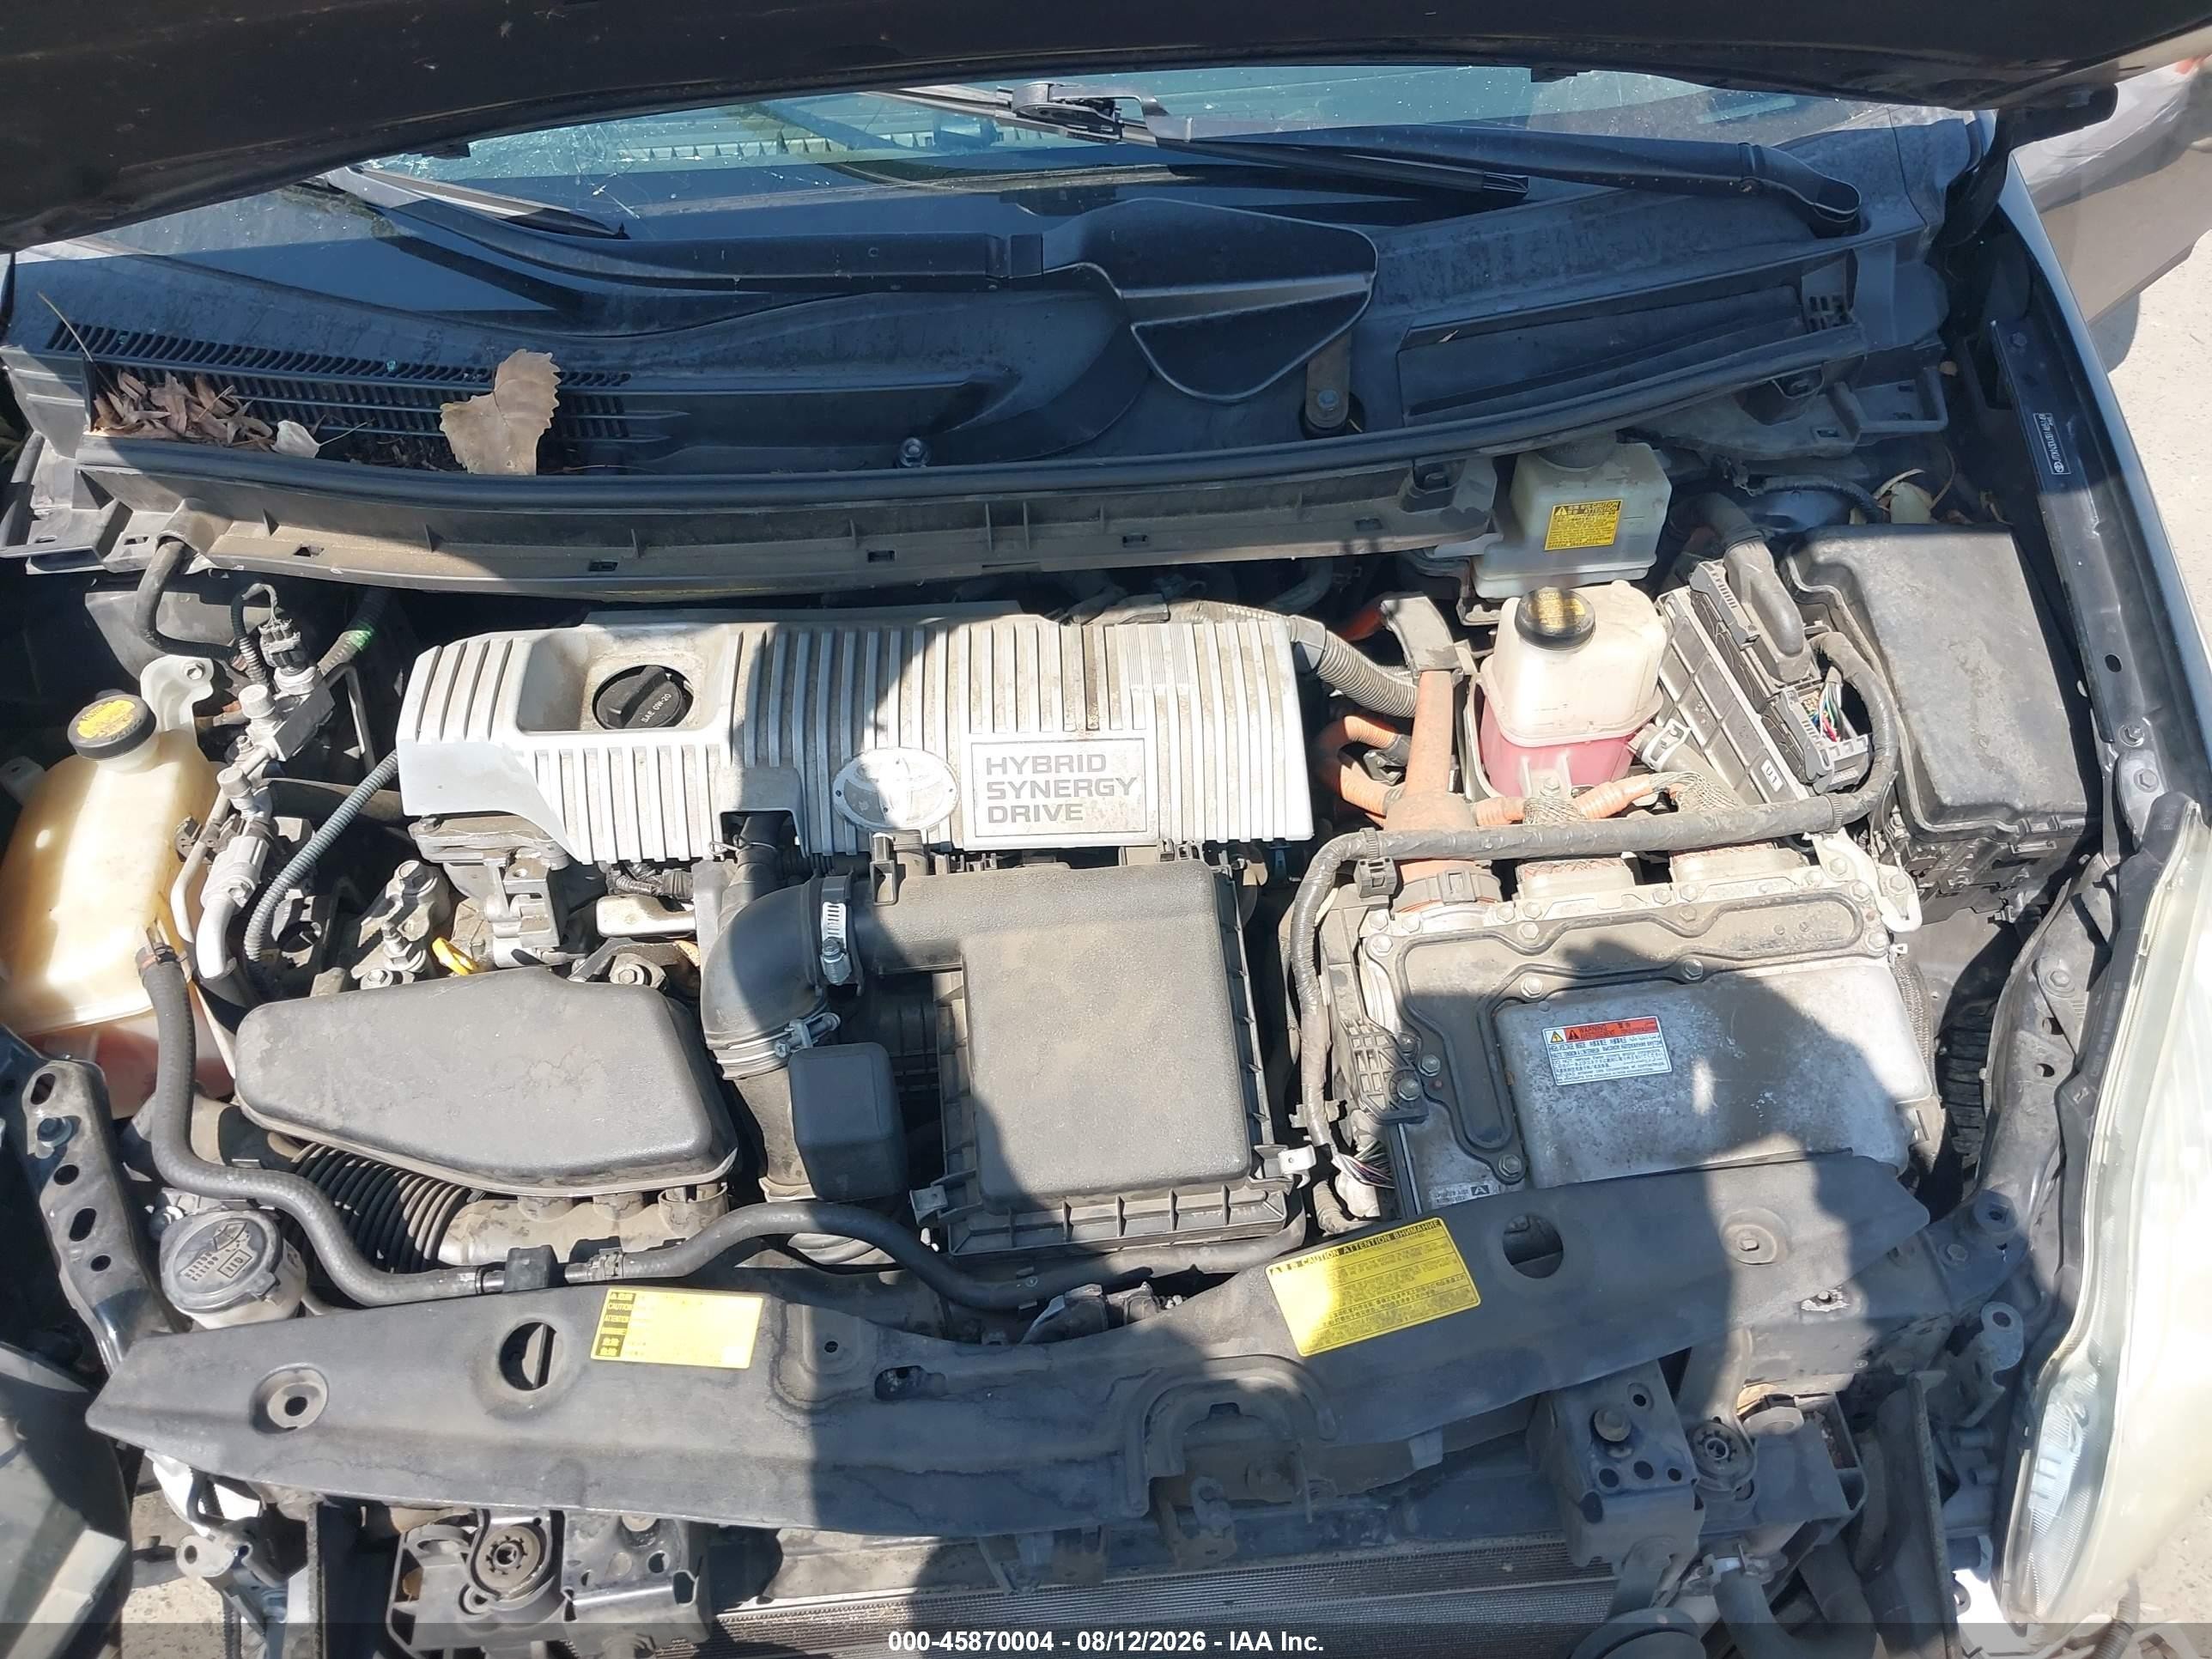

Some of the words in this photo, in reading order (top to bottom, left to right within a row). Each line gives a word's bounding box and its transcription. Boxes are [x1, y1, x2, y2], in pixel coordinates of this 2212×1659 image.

[641, 710, 655, 723] SAE
[653, 693, 672, 710] 0W-20
[986, 754, 1106, 775] HYBRID
[987, 777, 1137, 799] SYNERGY
[988, 804, 1084, 823] DRIVE
[1302, 1249, 1340, 1267] CAUTION
[1343, 1235, 1391, 1254] ATTENTION
[1394, 1221, 1440, 1239] ВНИМАНИЕ
